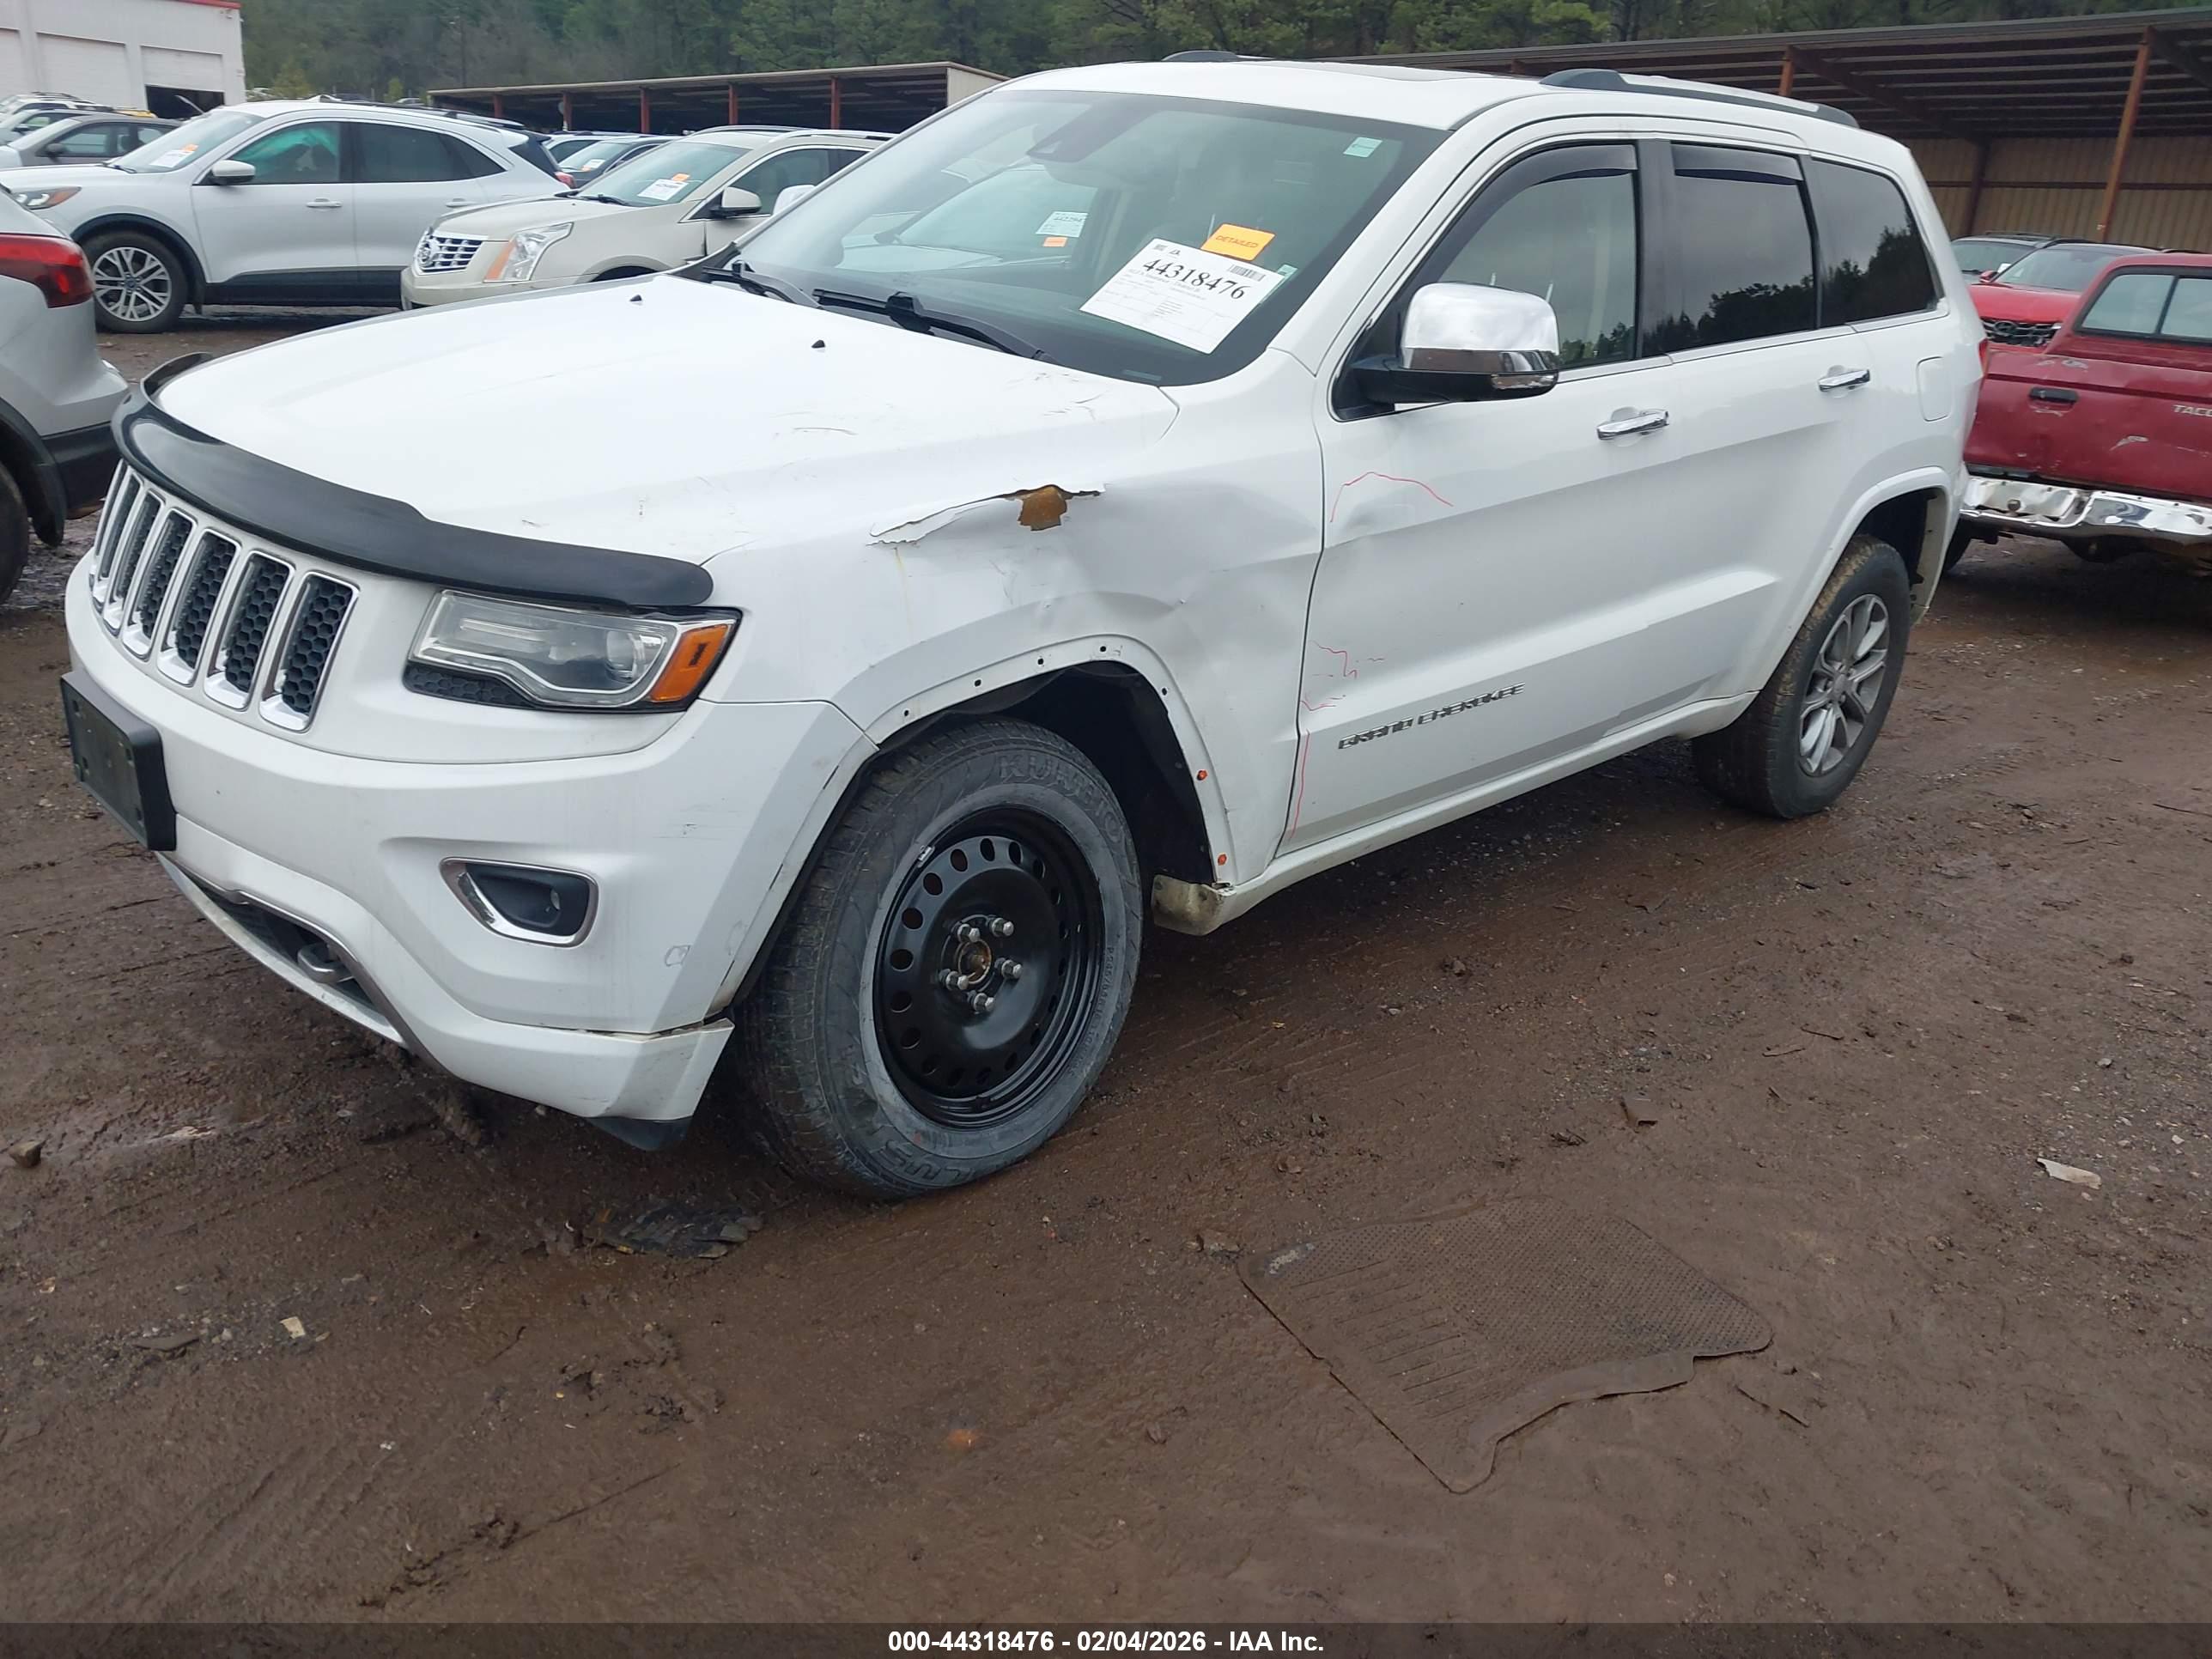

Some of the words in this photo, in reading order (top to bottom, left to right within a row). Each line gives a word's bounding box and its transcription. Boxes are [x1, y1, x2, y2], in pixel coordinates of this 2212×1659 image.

[1215, 235, 1259, 248] DETAILED
[1143, 258, 1251, 300] 44318476
[1338, 716, 1414, 750] GRAND
[1418, 682, 1526, 725] CHEROKEE
